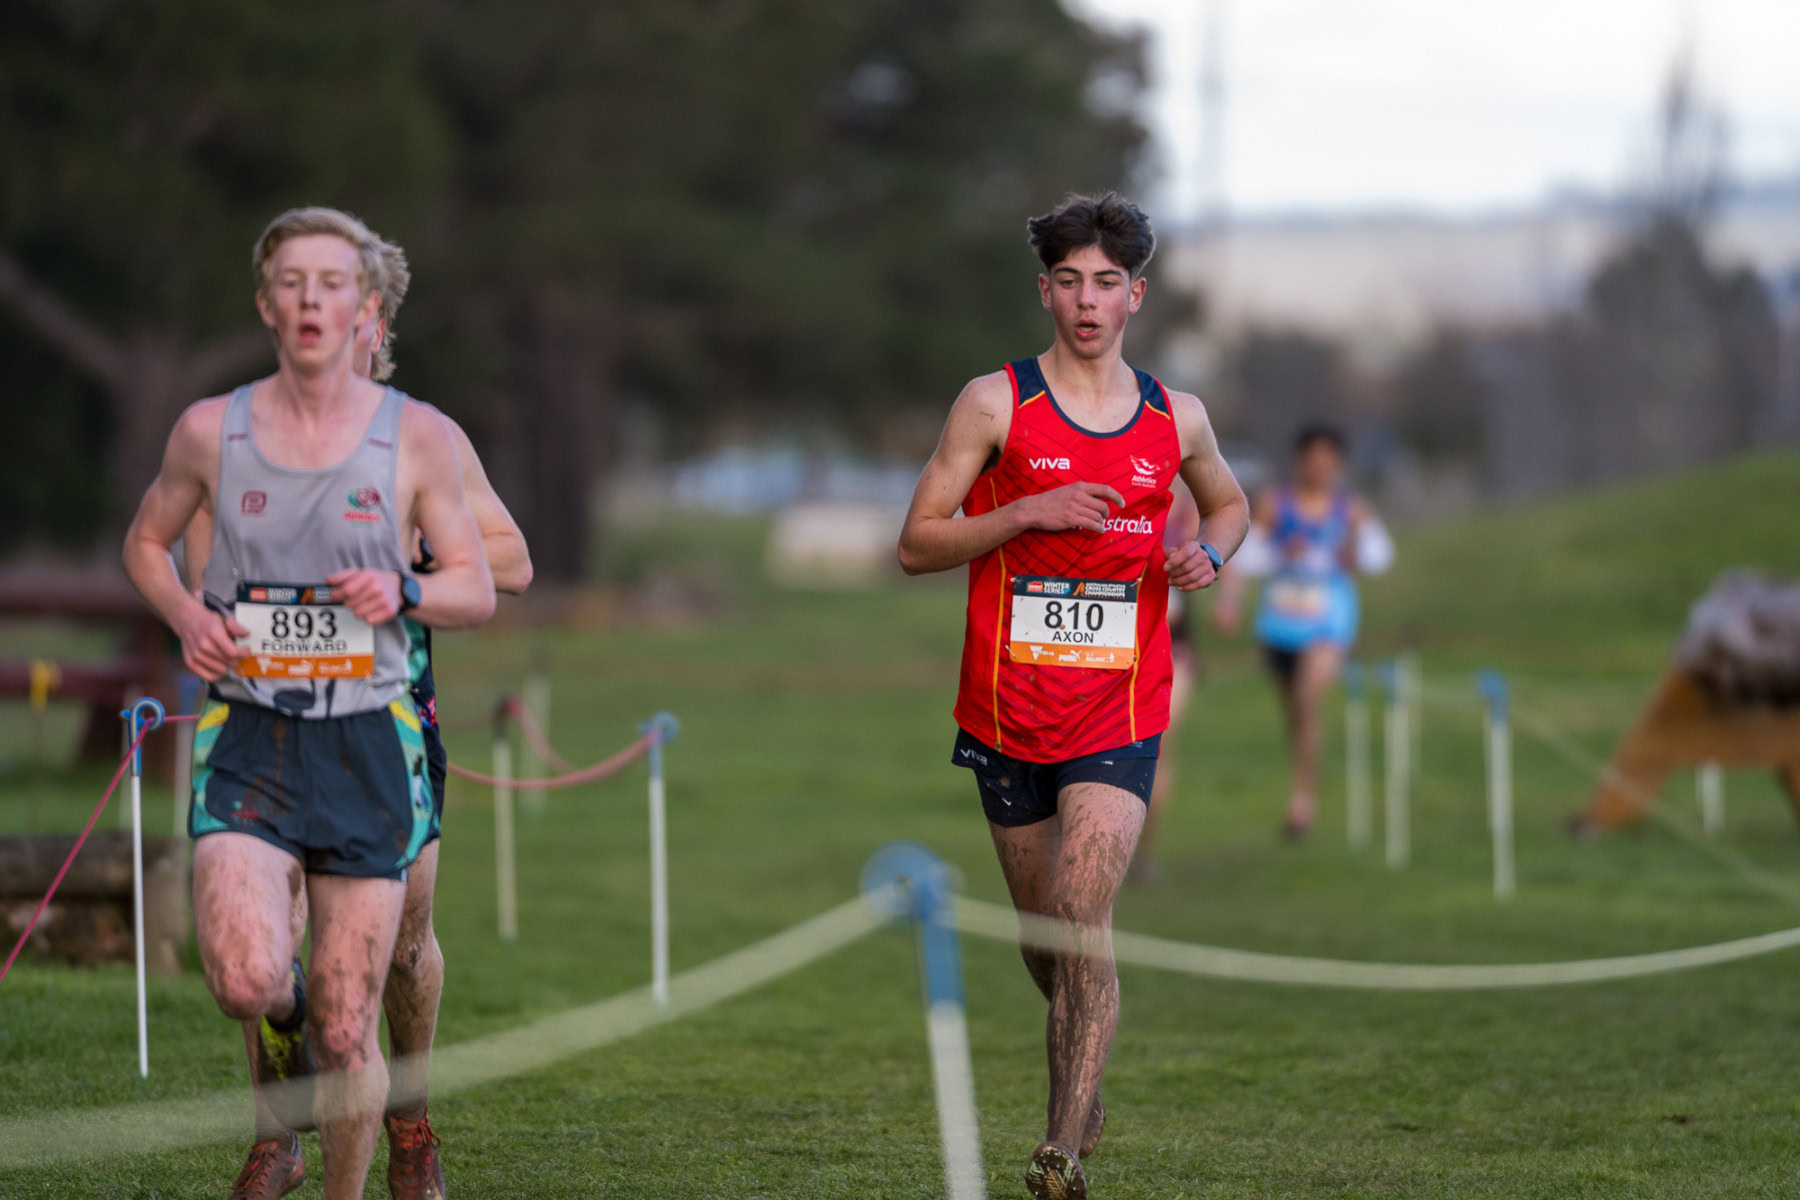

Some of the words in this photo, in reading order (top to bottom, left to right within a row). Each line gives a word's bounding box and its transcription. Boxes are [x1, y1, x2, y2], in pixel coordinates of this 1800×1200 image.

[1131, 474, 1157, 484] Athletics
[1044, 581, 1070, 589] WINTER
[1044, 600, 1104, 631] 810
[271, 608, 337, 639] 893
[1052, 631, 1094, 643] AXON
[261, 640, 348, 655] FORWARD
